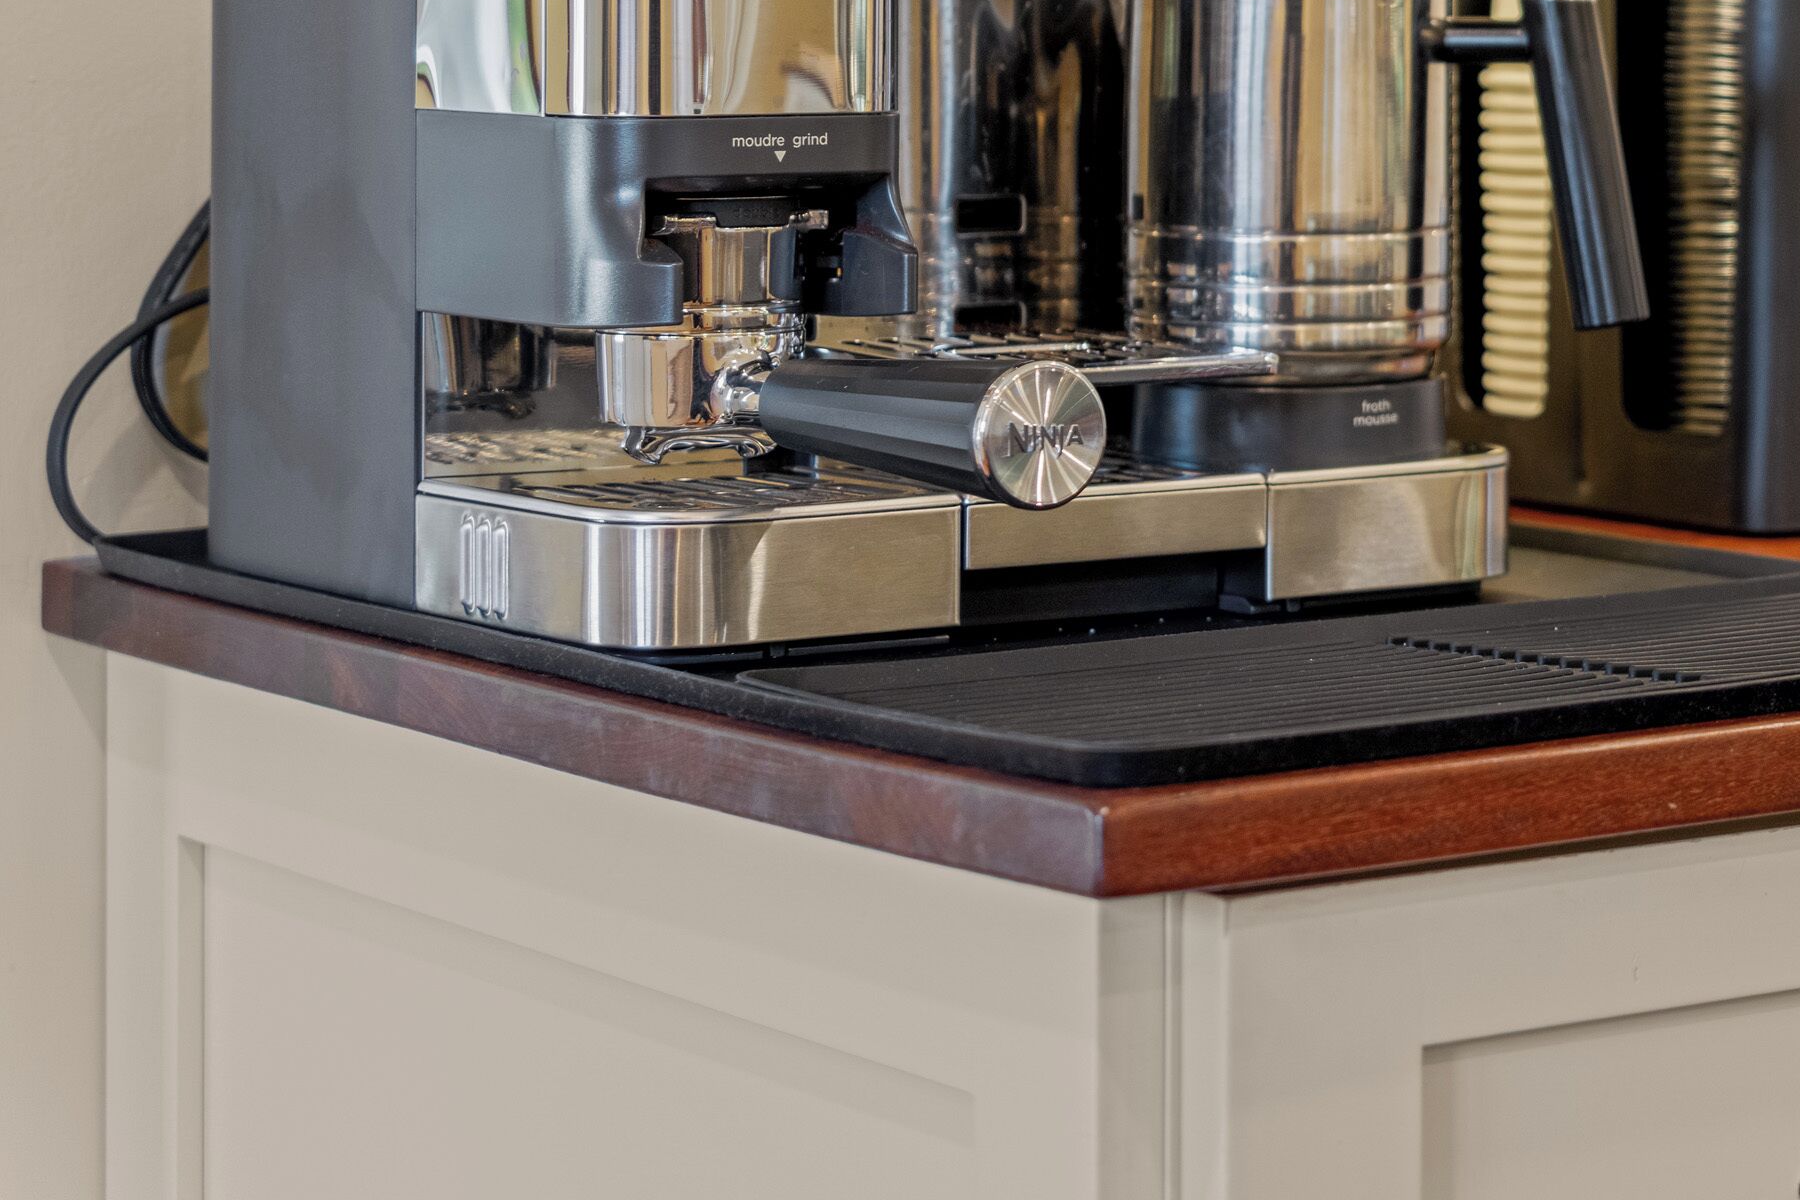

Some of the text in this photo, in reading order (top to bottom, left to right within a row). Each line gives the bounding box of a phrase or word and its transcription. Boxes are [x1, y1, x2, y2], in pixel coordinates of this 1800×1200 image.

[732, 132, 829, 148] moudre grind
[1361, 399, 1392, 413] froth
[1353, 412, 1399, 427] mousse
[1003, 421, 1084, 460] NINJA
